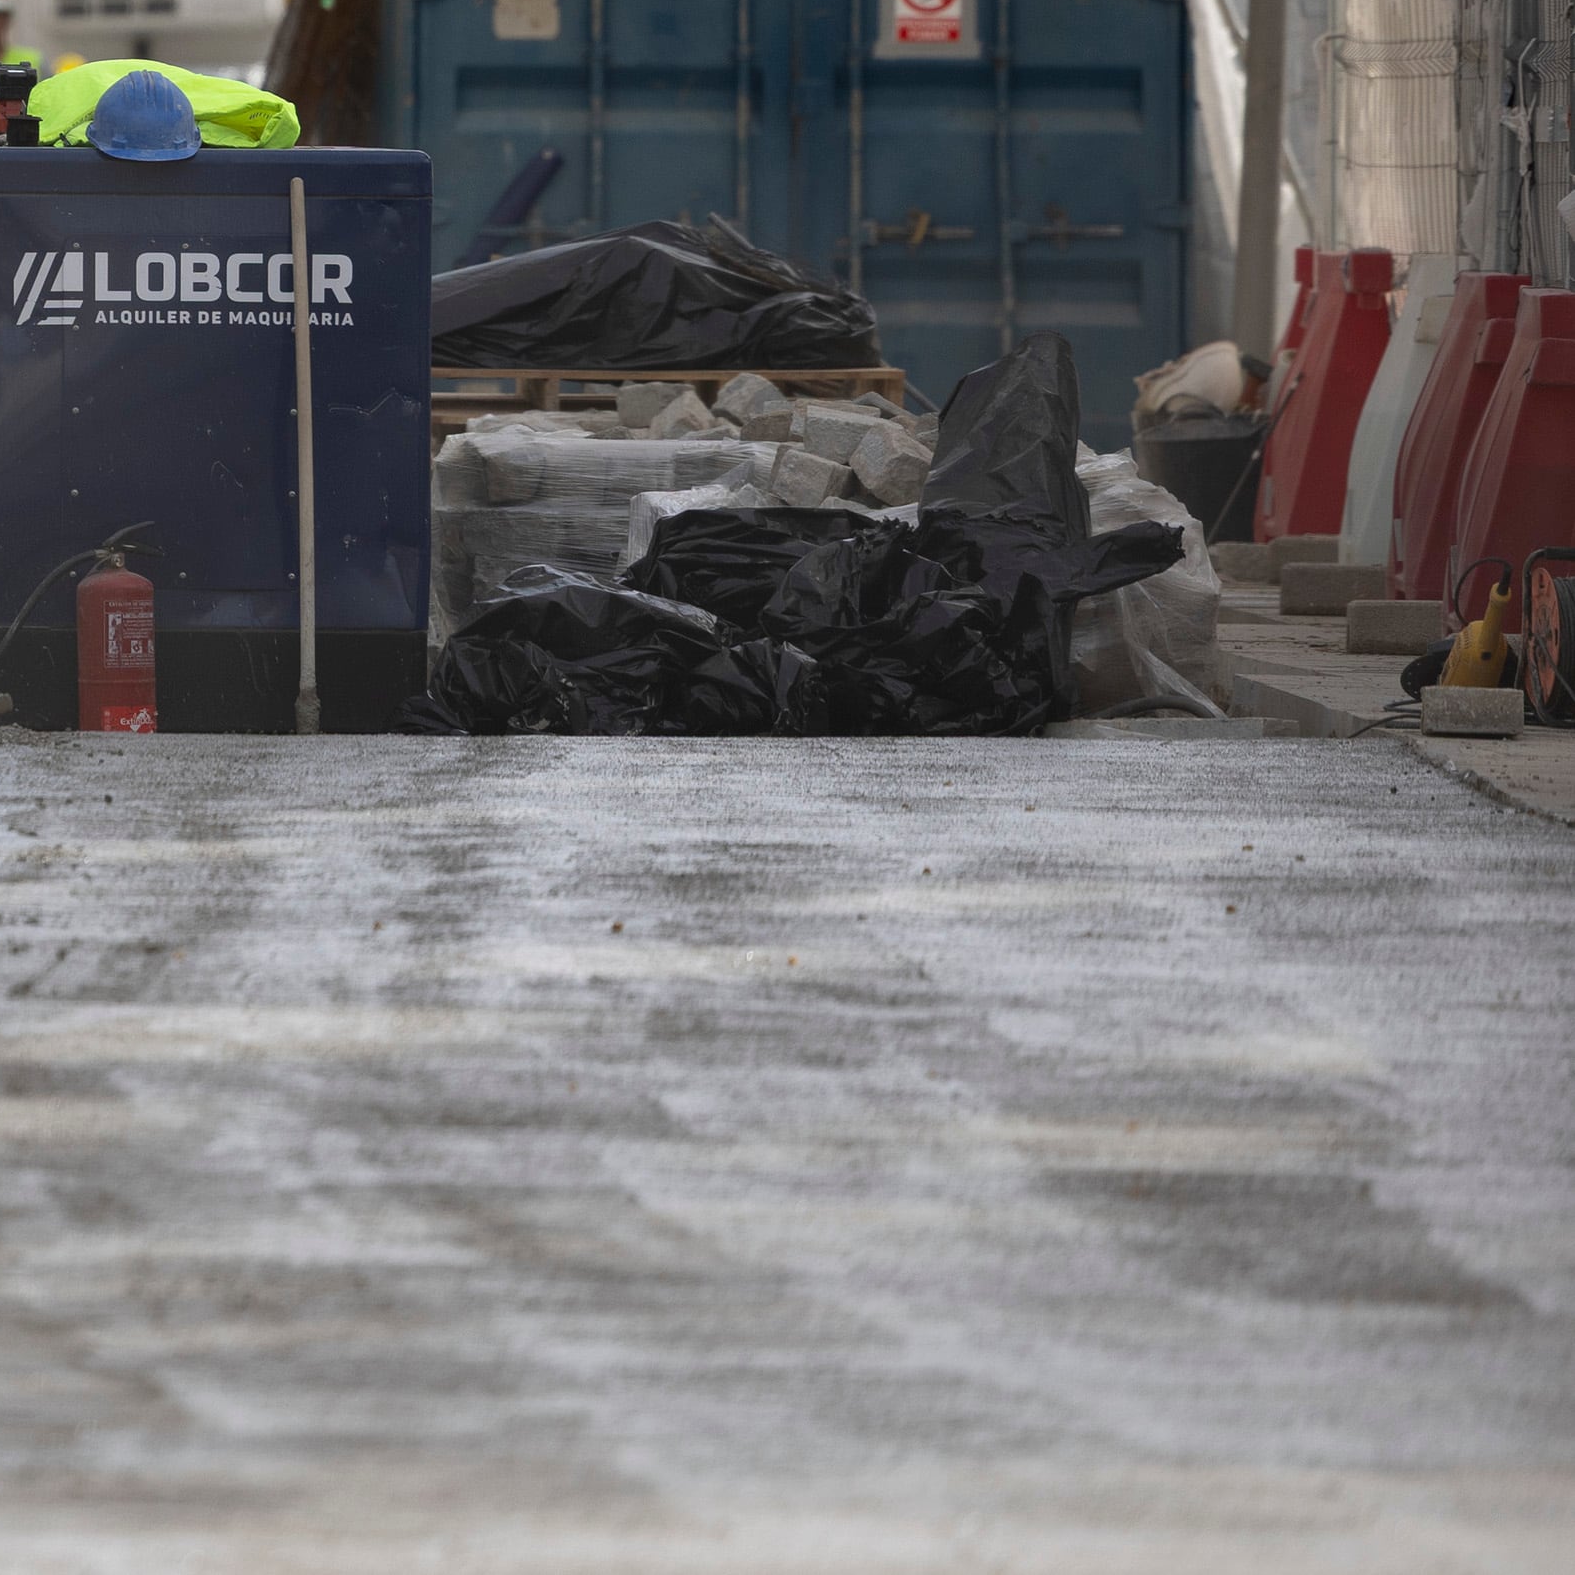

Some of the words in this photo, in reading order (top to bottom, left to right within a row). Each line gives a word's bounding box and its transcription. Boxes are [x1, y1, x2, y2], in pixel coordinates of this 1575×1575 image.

[94, 252, 354, 304] LOBCOR
[95, 309, 191, 325] ALQUILER
[197, 310, 222, 325] DE
[229, 310, 355, 327] MAQUIARIA
